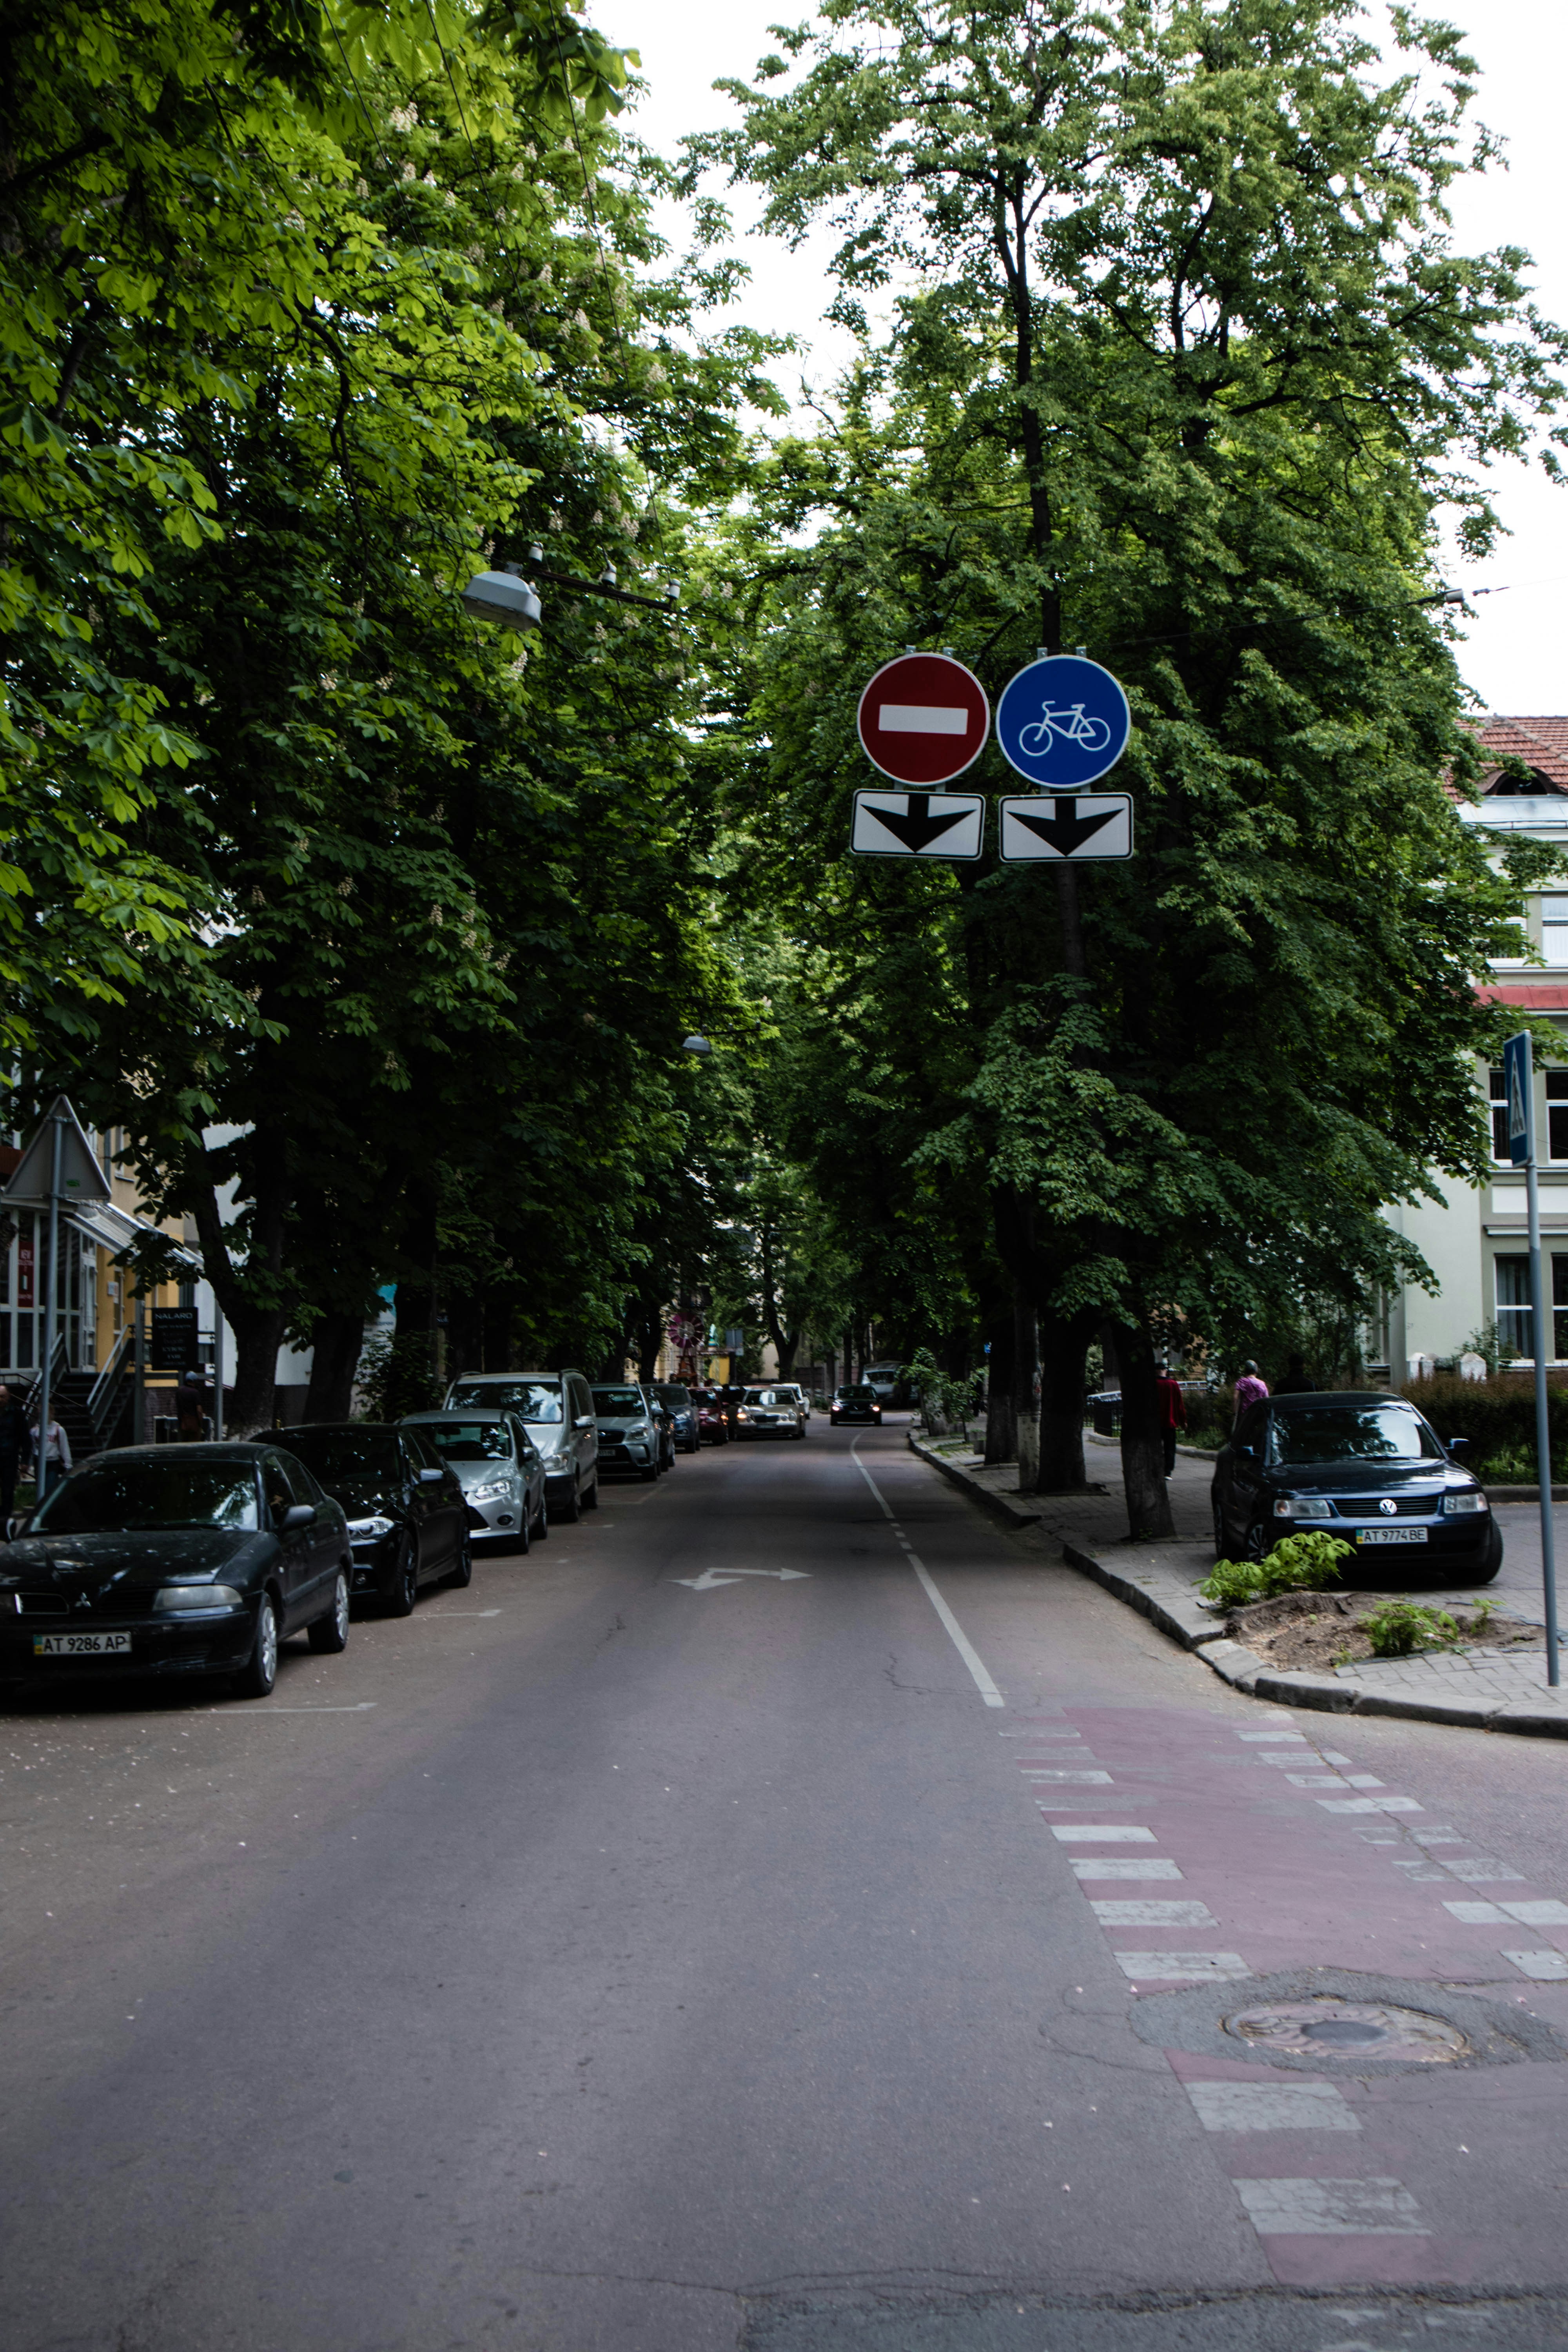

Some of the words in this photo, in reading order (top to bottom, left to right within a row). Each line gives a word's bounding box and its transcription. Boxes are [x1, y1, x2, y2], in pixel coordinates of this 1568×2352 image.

[1364, 1531, 1379, 1542] AT
[1381, 1530, 1407, 1541] 9774
[1409, 1529, 1425, 1540] BE
[44, 1637, 64, 1652] AT
[67, 1636, 101, 1651] 9286
[105, 1635, 127, 1650] AP
